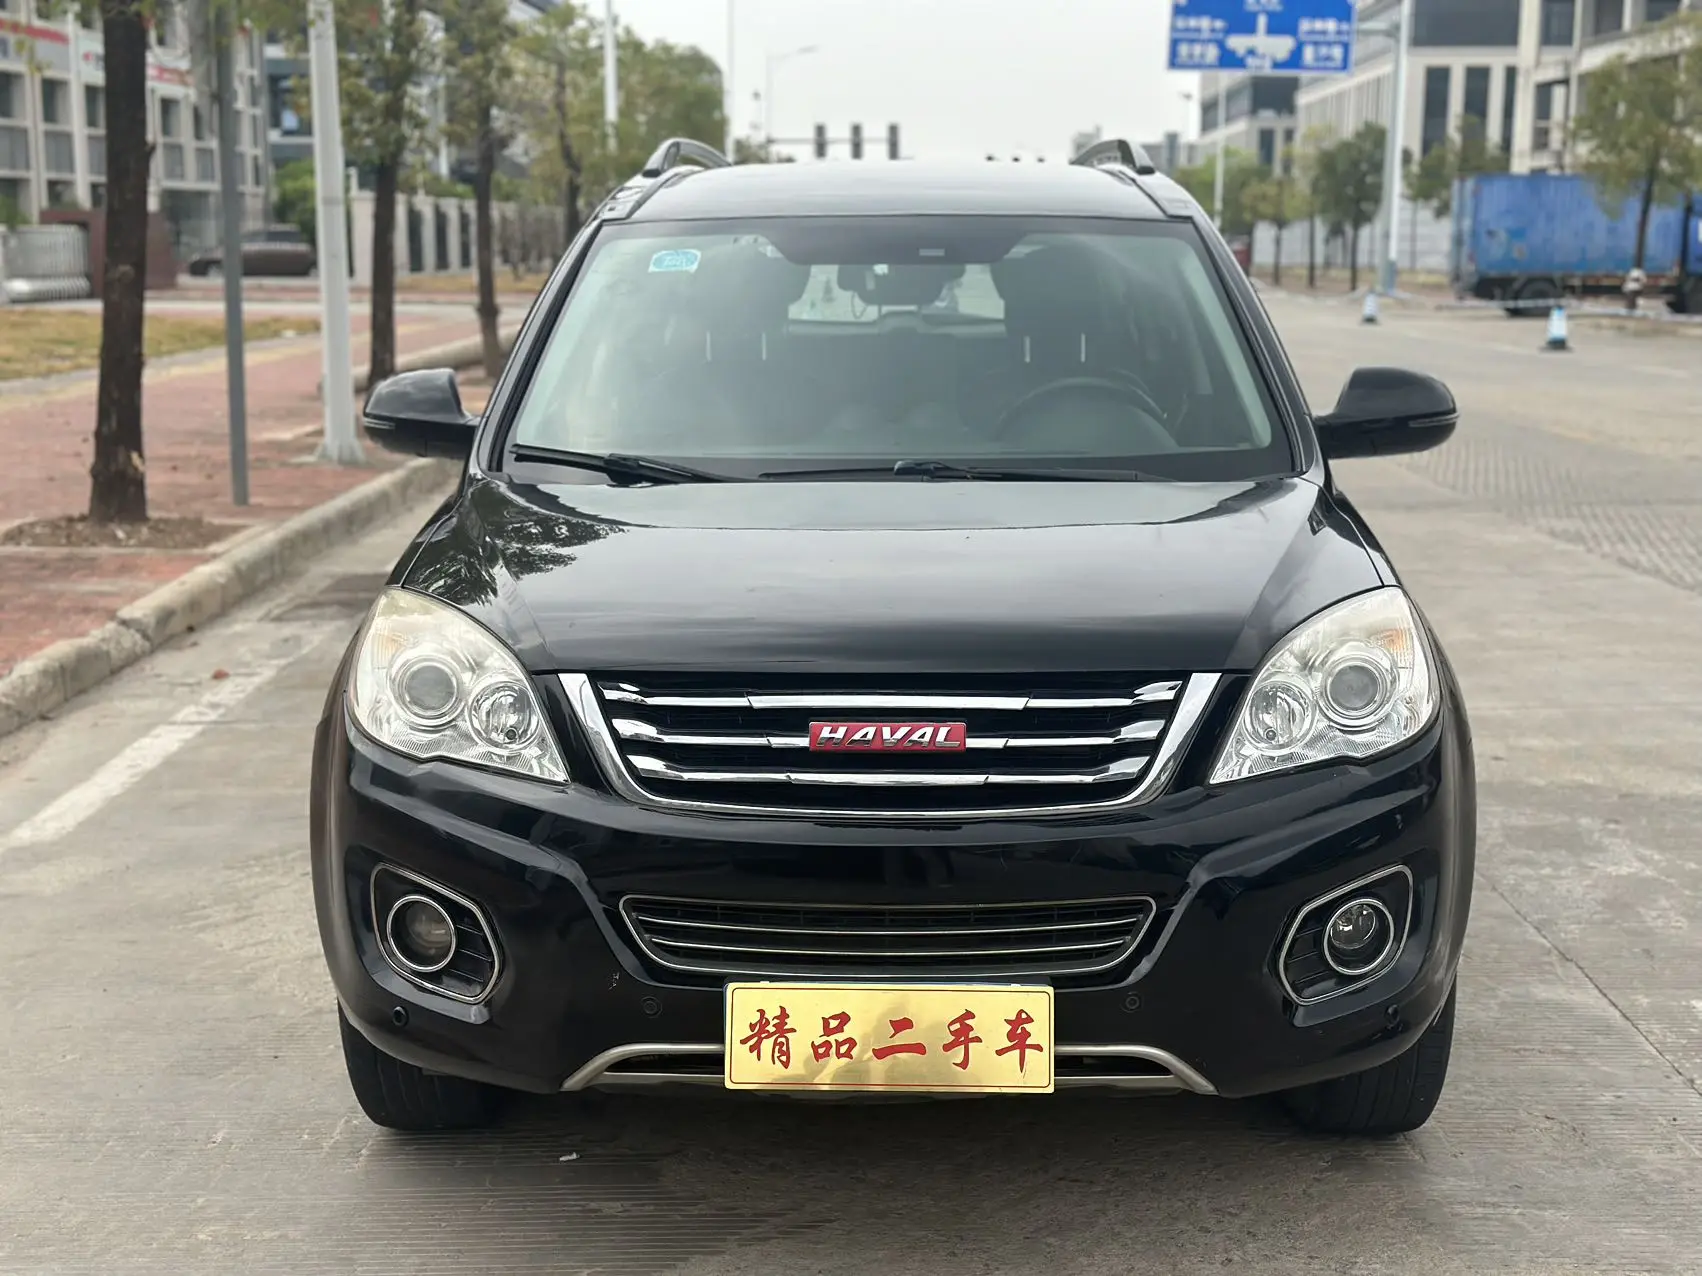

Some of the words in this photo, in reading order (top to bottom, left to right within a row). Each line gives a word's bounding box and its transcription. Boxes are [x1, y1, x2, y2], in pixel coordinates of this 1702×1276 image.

[816, 726, 960, 747] HAVAL
[740, 1005, 1043, 1073] 精品二手车
